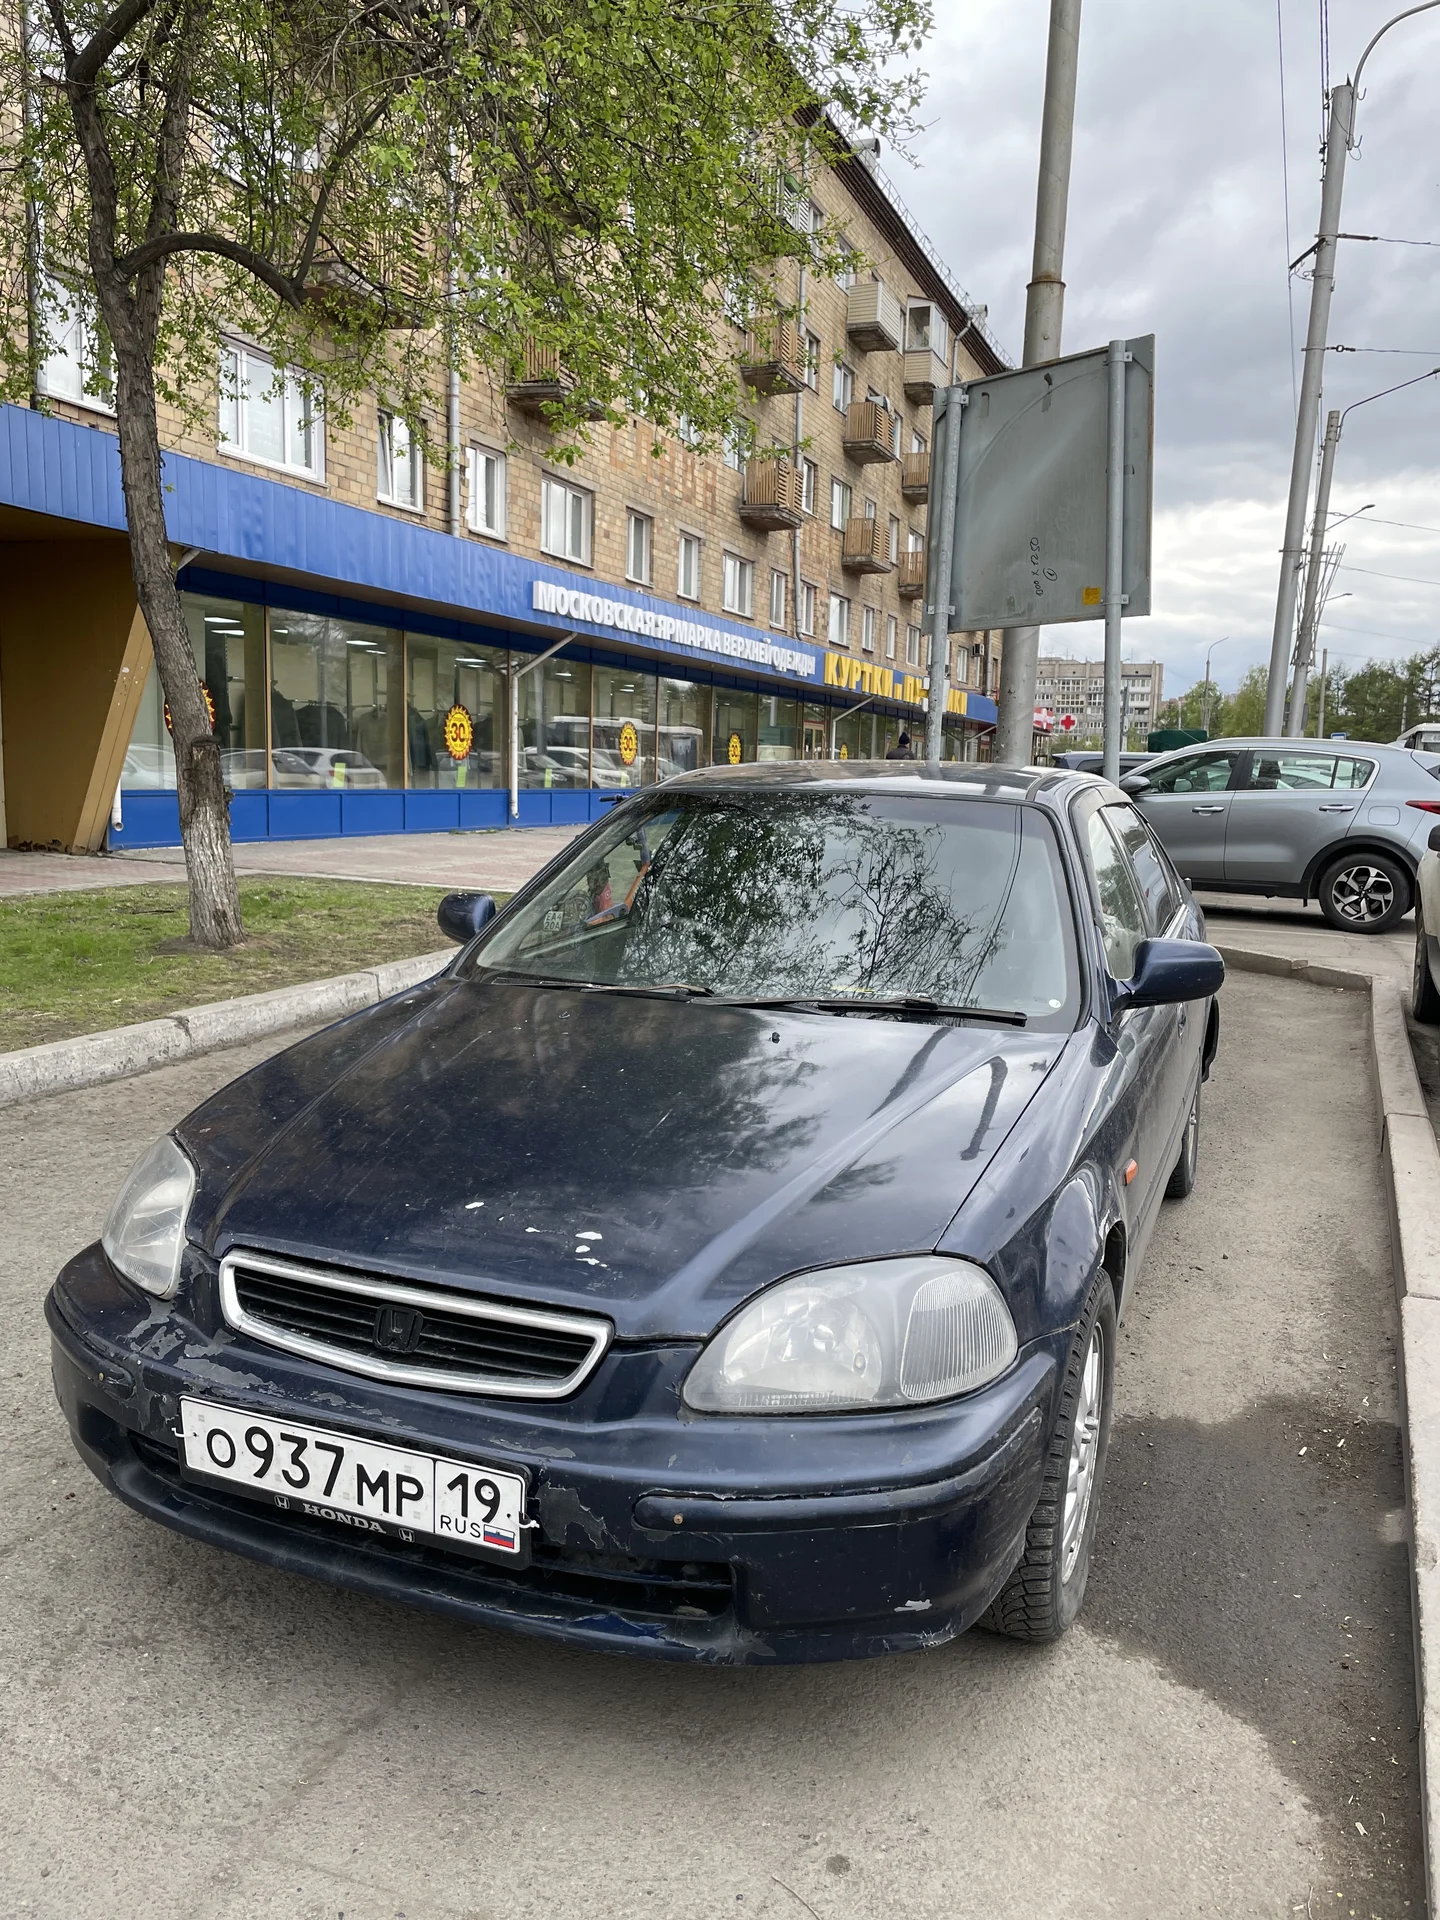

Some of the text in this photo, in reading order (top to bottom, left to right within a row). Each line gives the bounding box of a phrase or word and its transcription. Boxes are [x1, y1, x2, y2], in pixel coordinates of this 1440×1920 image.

[532, 580, 816, 677] МОСКОВСКАЯ ЯРМАРКА ВЕРХНЕЙ ОДЕЖДЫ
[824, 652, 893, 698] КУРТКИ
[302, 1502, 387, 1534] HONDA
[447, 1472, 501, 1523] 19
[440, 1514, 481, 1538] RUS
